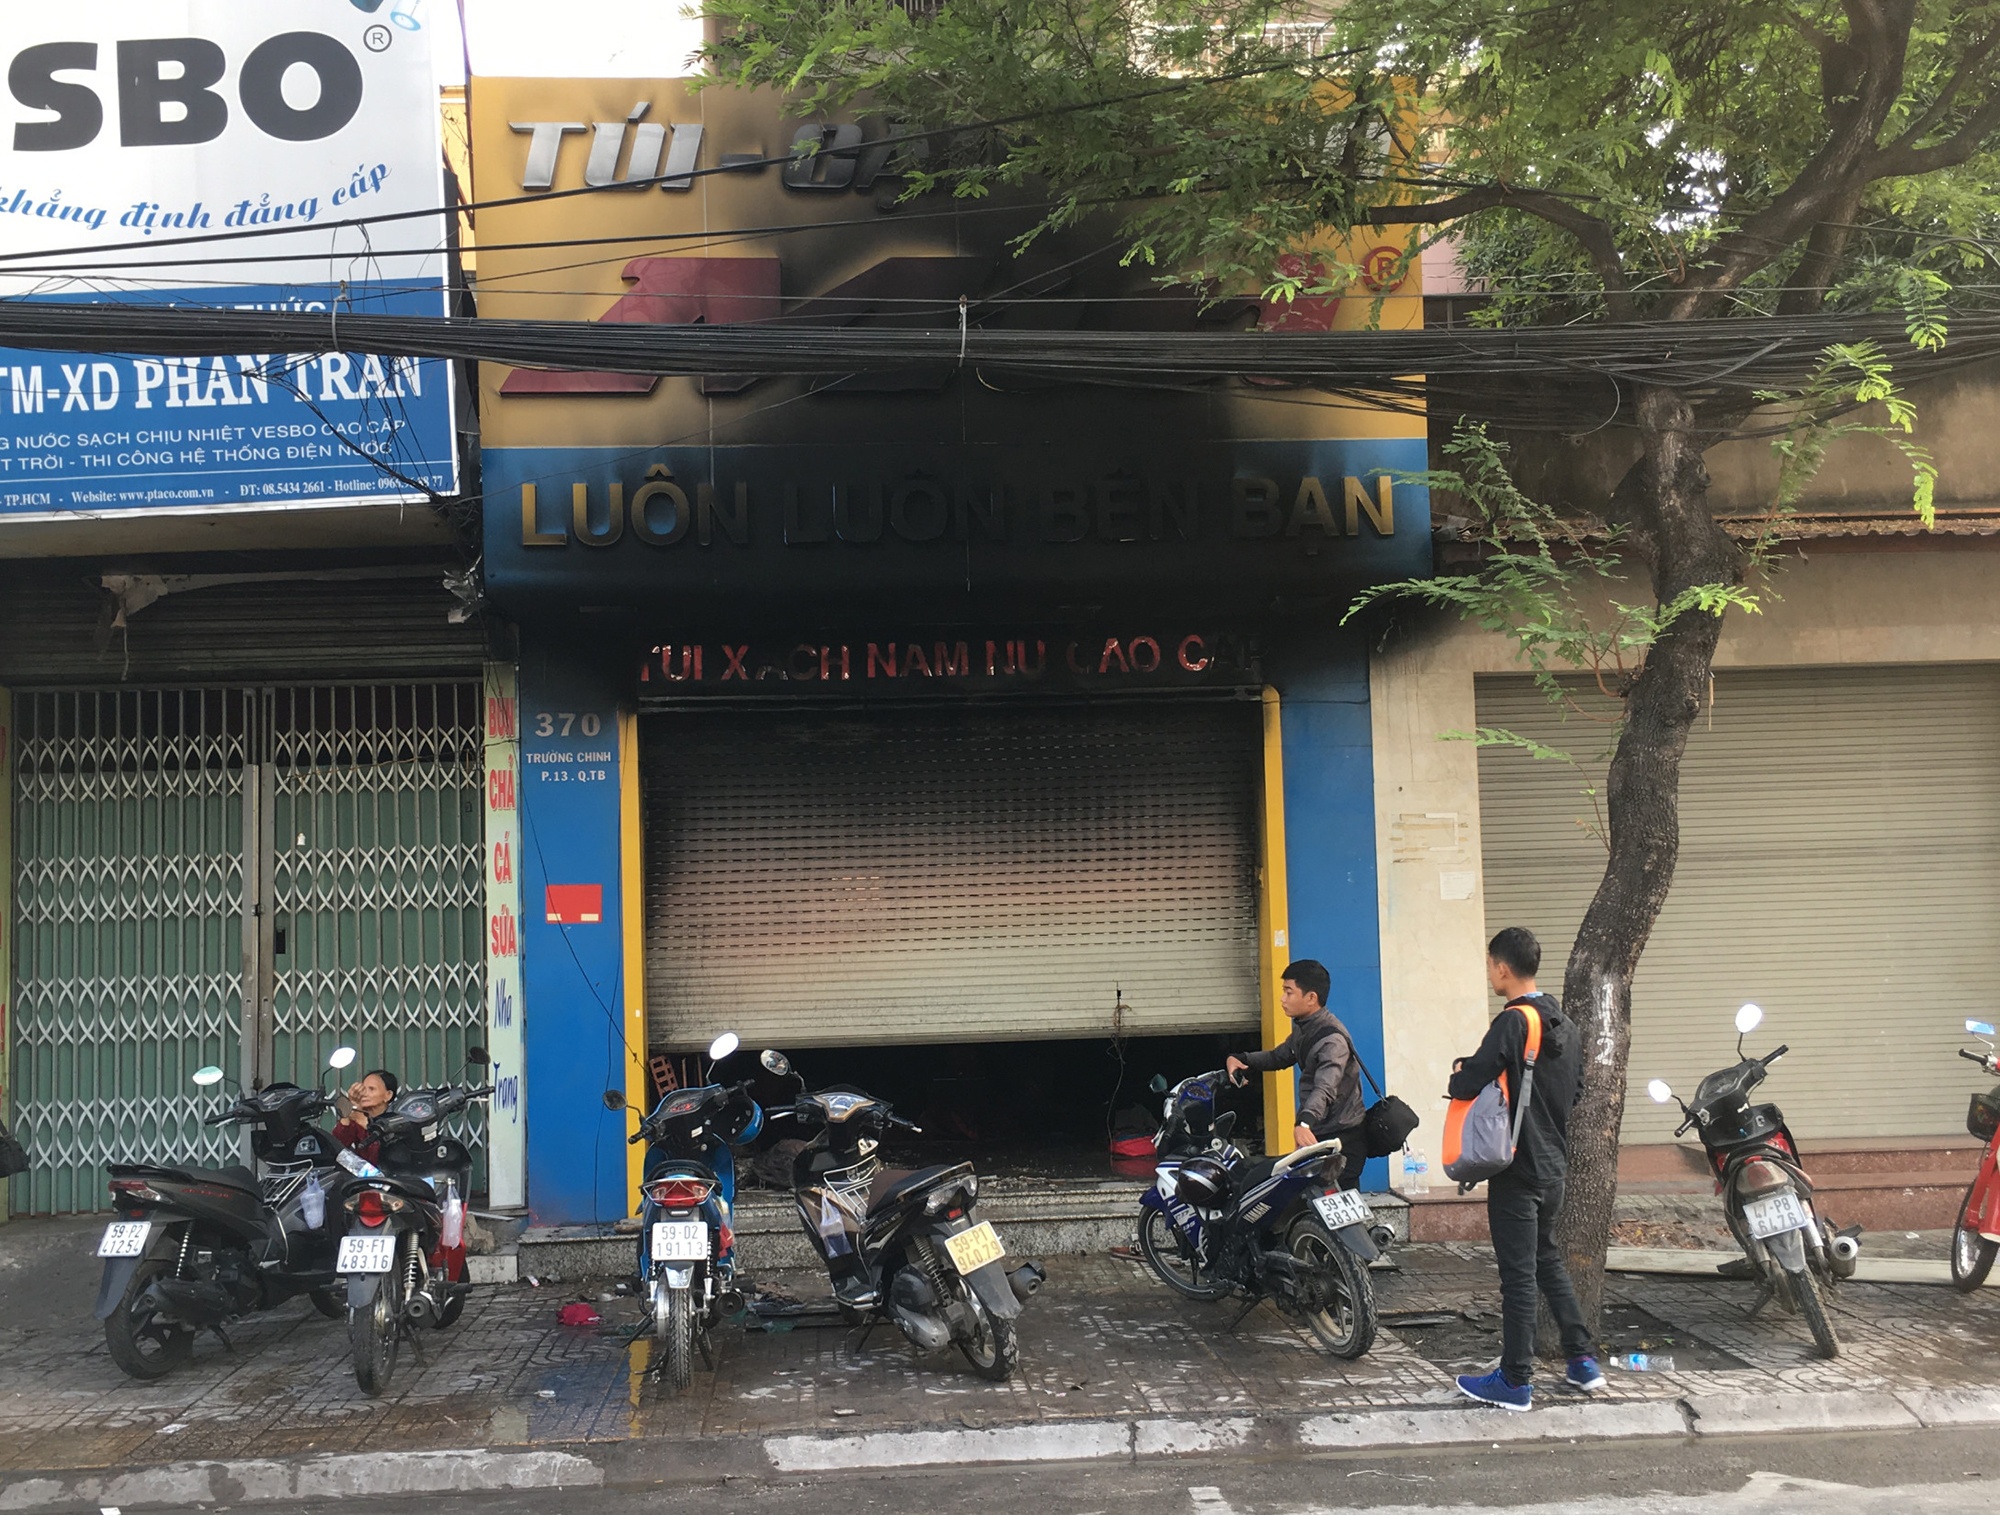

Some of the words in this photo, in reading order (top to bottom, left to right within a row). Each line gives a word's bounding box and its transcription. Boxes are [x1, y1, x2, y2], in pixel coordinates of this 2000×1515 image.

[7, 31, 363, 152] SBO
[508, 101, 705, 192] TÚI
[120, 202, 214, 235] định
[224, 193, 323, 230] đẳng
[331, 162, 393, 207] cấp
[16, 432, 71, 449] NƯỚC
[77, 432, 130, 448] SẠCH
[136, 430, 182, 445] CHỊU
[188, 425, 245, 442] NHIỆT
[251, 424, 316, 439] VESBO
[321, 422, 362, 435] CAO
[18, 454, 62, 470] TRỜI
[80, 454, 111, 467] THI
[117, 450, 173, 466] CÔNG
[180, 447, 206, 465] HỆ
[212, 444, 280, 461] THỐNG
[286, 443, 331, 460] ĐIỆN
[4, 493, 50, 506] TP.HCM
[71, 490, 117, 503] Website:
[119, 488, 214, 502] www.ptaco.com.vn
[240, 484, 260, 496] ĐT:
[262, 482, 300, 495] 08.5434
[303, 481, 325, 493] 2661
[334, 479, 376, 492] Hotline:
[521, 463, 749, 547] LUÔN
[867, 641, 969, 679] NAM
[535, 712, 601, 737] 370
[526, 748, 574, 764] TRƯỜNG
[577, 751, 611, 763] CHINH
[489, 753, 516, 811] CHẢ
[577, 770, 607, 782] Q.TB
[494, 831, 513, 884] CÁ
[491, 904, 517, 957] SỨA
[494, 978, 512, 1029] Nha
[493, 1061, 518, 1124] Trang
[1326, 1205, 1370, 1228] 583.12
[1753, 1197, 1791, 1219] 47-P8
[110, 1224, 143, 1239] 59-P2
[952, 1227, 988, 1254] 59-P1
[102, 1239, 140, 1254] 412.54
[348, 1239, 386, 1254] 59-F1
[656, 1241, 703, 1257] 191.13
[957, 1241, 1001, 1271] 940.79
[341, 1255, 389, 1269] 483.16
